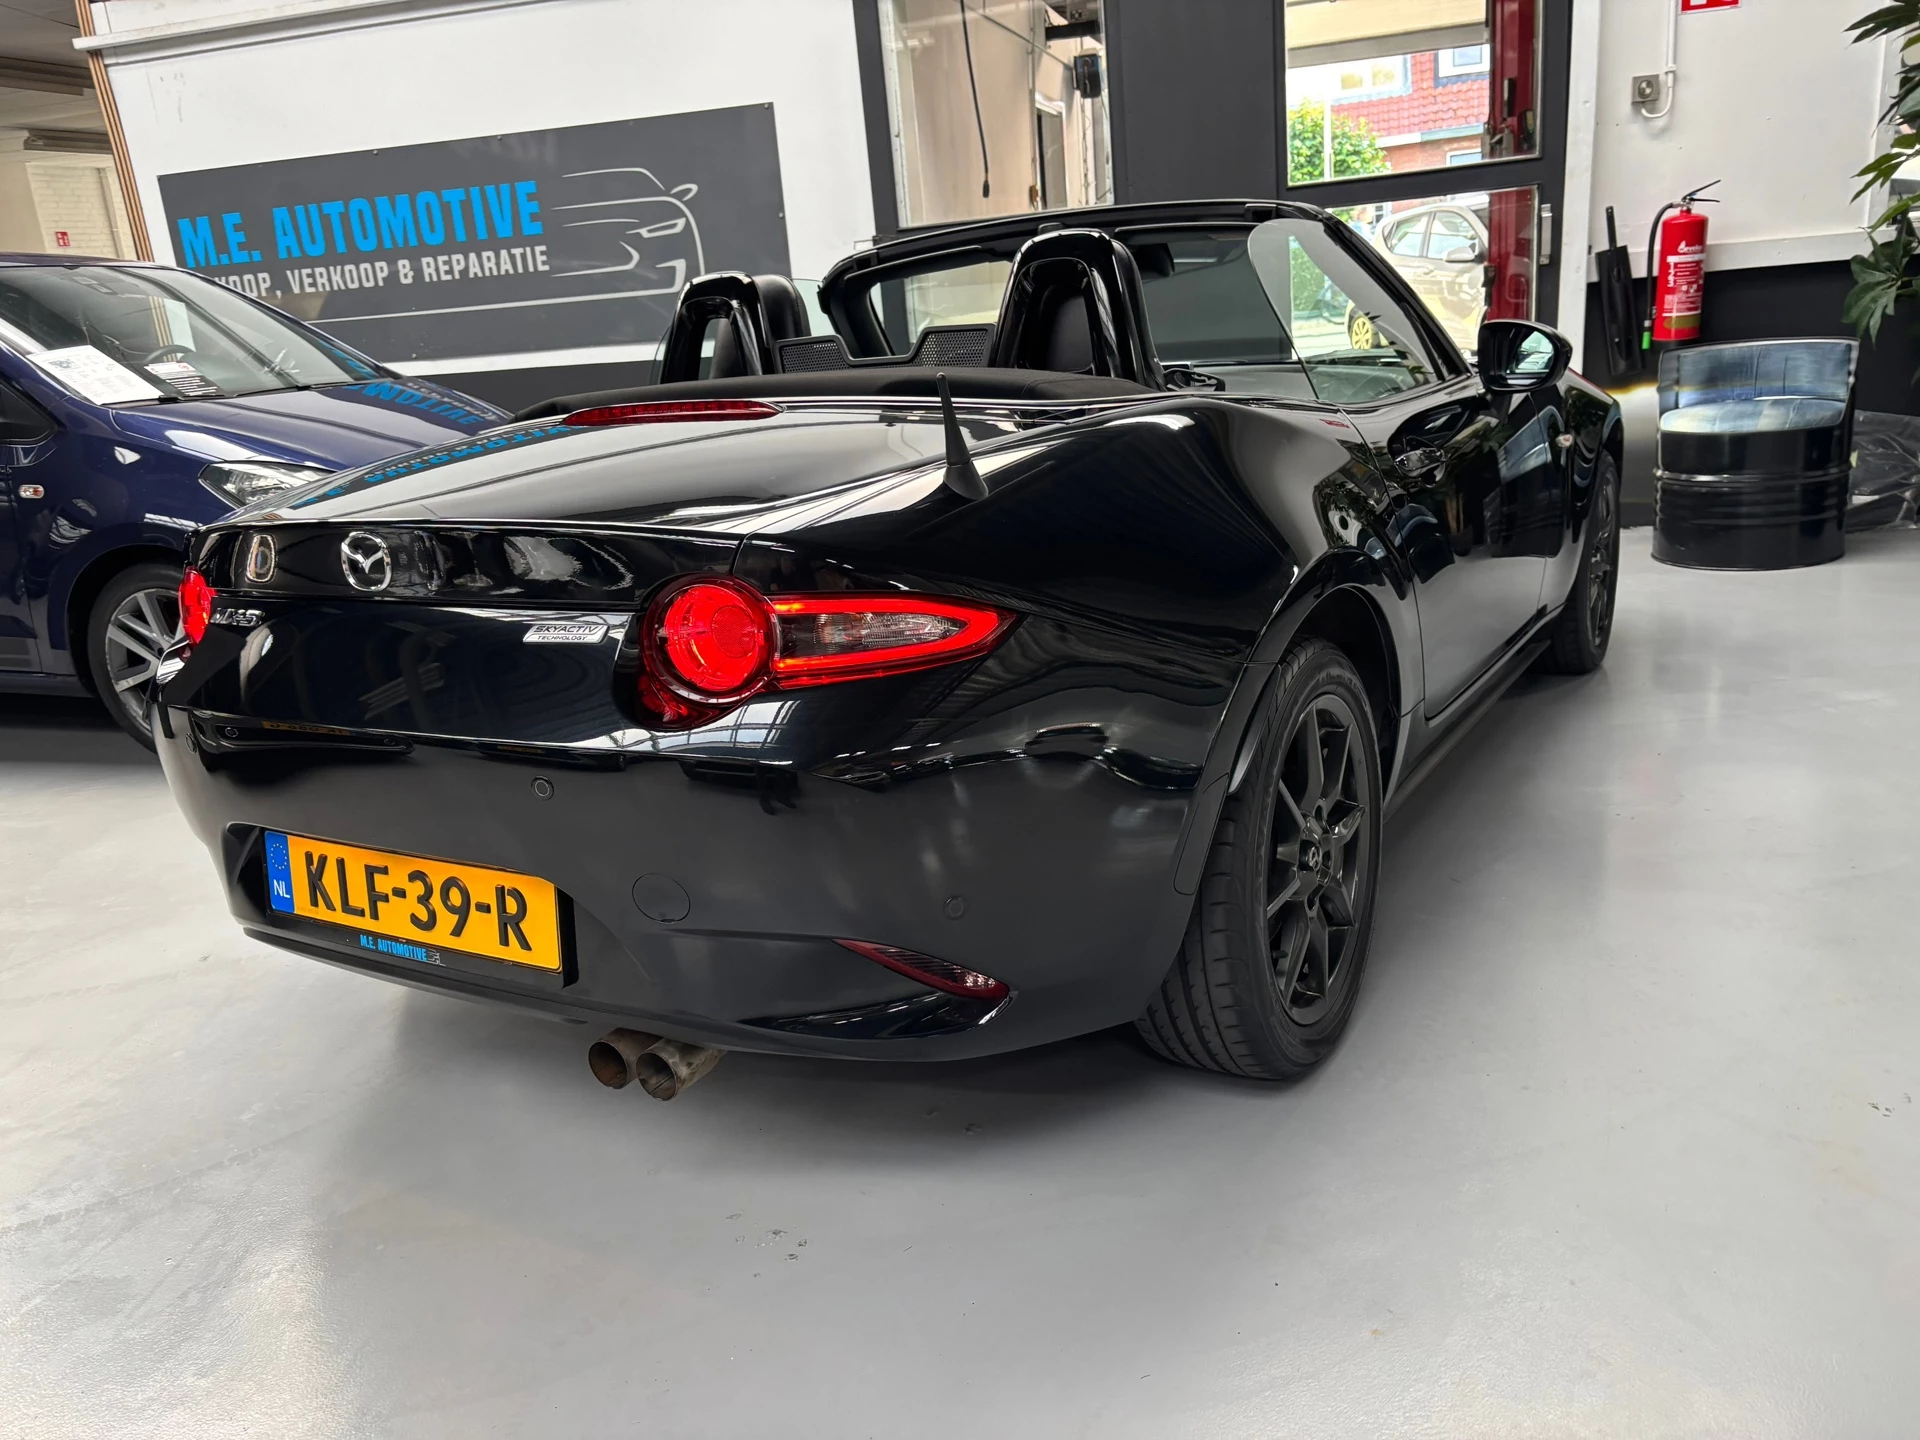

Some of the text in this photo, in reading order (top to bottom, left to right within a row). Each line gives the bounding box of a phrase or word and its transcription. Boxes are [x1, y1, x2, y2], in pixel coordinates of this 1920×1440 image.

[177, 180, 544, 268] M.E. AUTOMOTIVE
[285, 261, 389, 294] VERKOOP
[397, 259, 415, 284] &
[420, 245, 550, 282] REPARATIE
[533, 625, 598, 633] SKYACTIV
[273, 879, 290, 898] NL
[304, 850, 532, 952] KLF-39-R
[360, 934, 427, 961] M.E. AUTOMOTIVE
